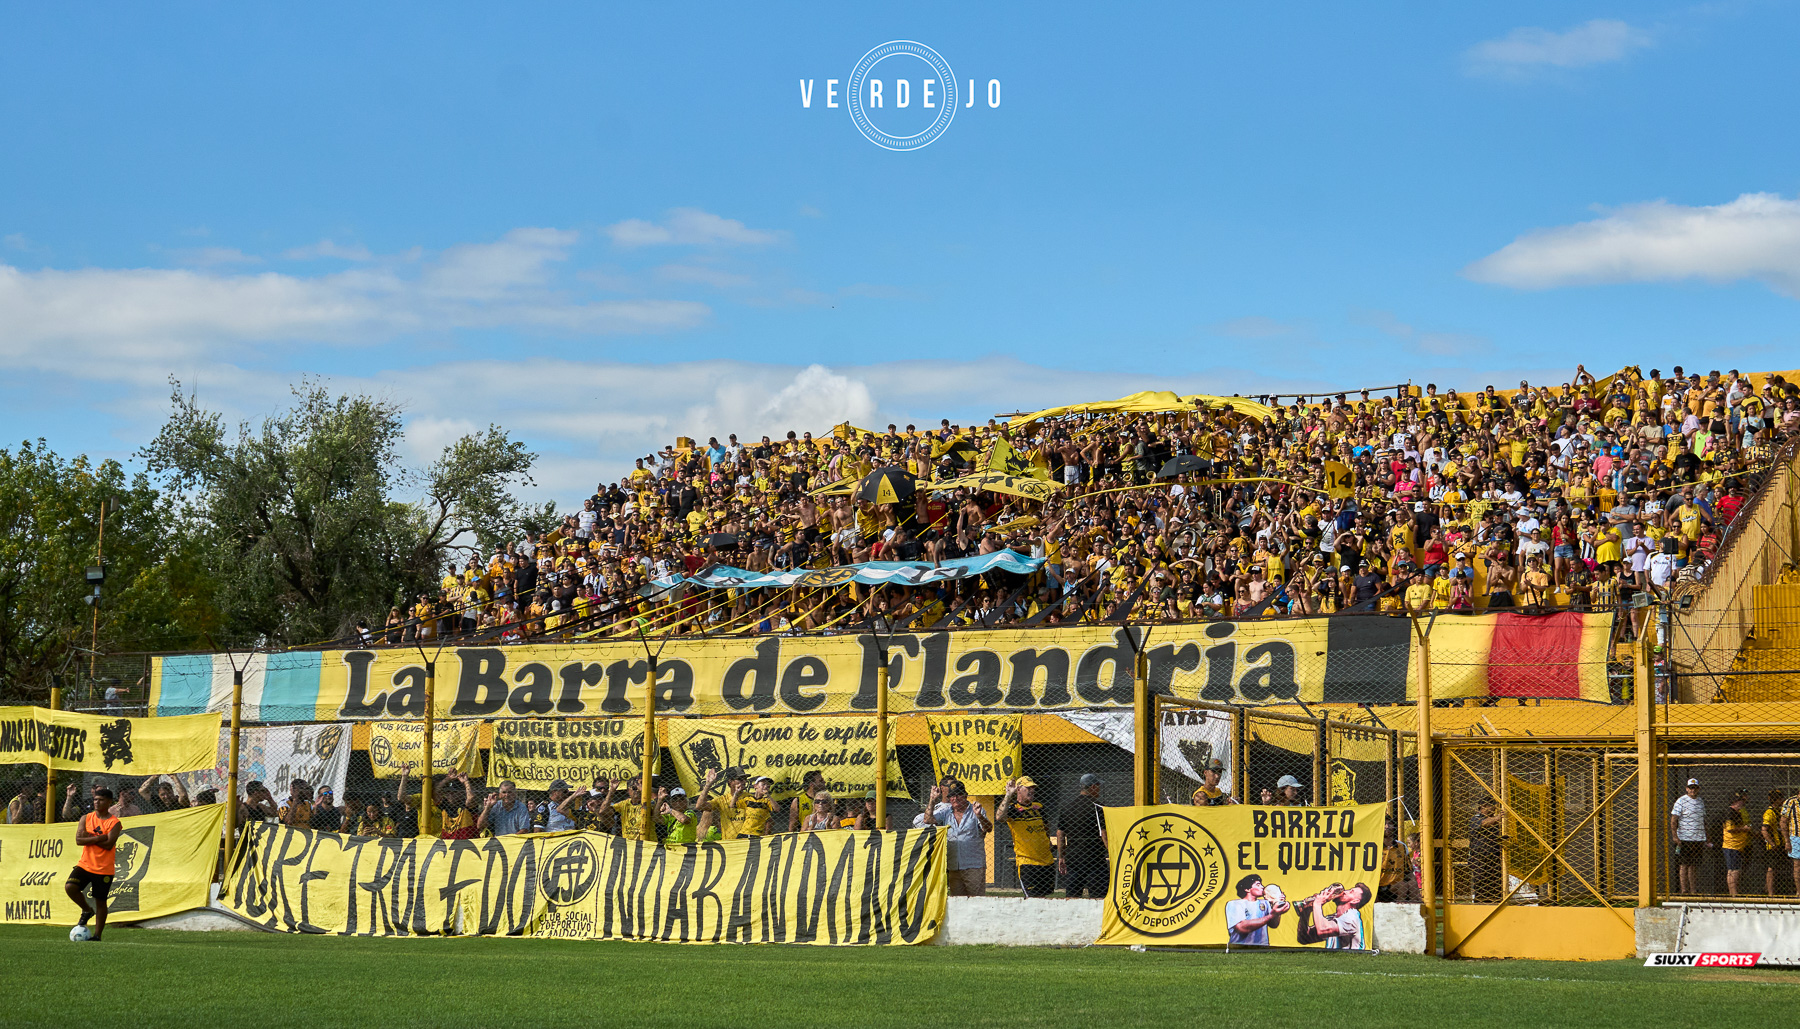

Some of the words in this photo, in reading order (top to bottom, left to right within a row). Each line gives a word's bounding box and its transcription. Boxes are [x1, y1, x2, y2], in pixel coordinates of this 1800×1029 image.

[1329, 471, 1353, 488] 14
[339, 650, 433, 718] La
[451, 647, 696, 716] Barra
[722, 637, 829, 713] de
[851, 622, 1300, 709] Flandria
[396, 723, 448, 732] VOLVERMOS
[497, 721, 554, 738] JORGE
[737, 721, 793, 745] Como
[799, 722, 819, 741] te
[823, 721, 886, 745] explic
[561, 741, 630, 760] ESTARAS
[951, 743, 964, 753] ES
[977, 741, 999, 752] DEL
[739, 747, 757, 769] Lo
[765, 748, 848, 768] esencial
[495, 759, 556, 781] Gracias
[558, 768, 589, 782] por
[1253, 810, 1355, 838] BARRIO
[29, 838, 63, 859] LUCHO
[1238, 841, 1268, 870] EL
[1278, 841, 1378, 875] QUINTO
[1122, 864, 1133, 888] CLUB
[1142, 904, 1195, 928] DEPORTIVO
[6, 900, 51, 921] MANTECA
[538, 912, 561, 922] CLUB
